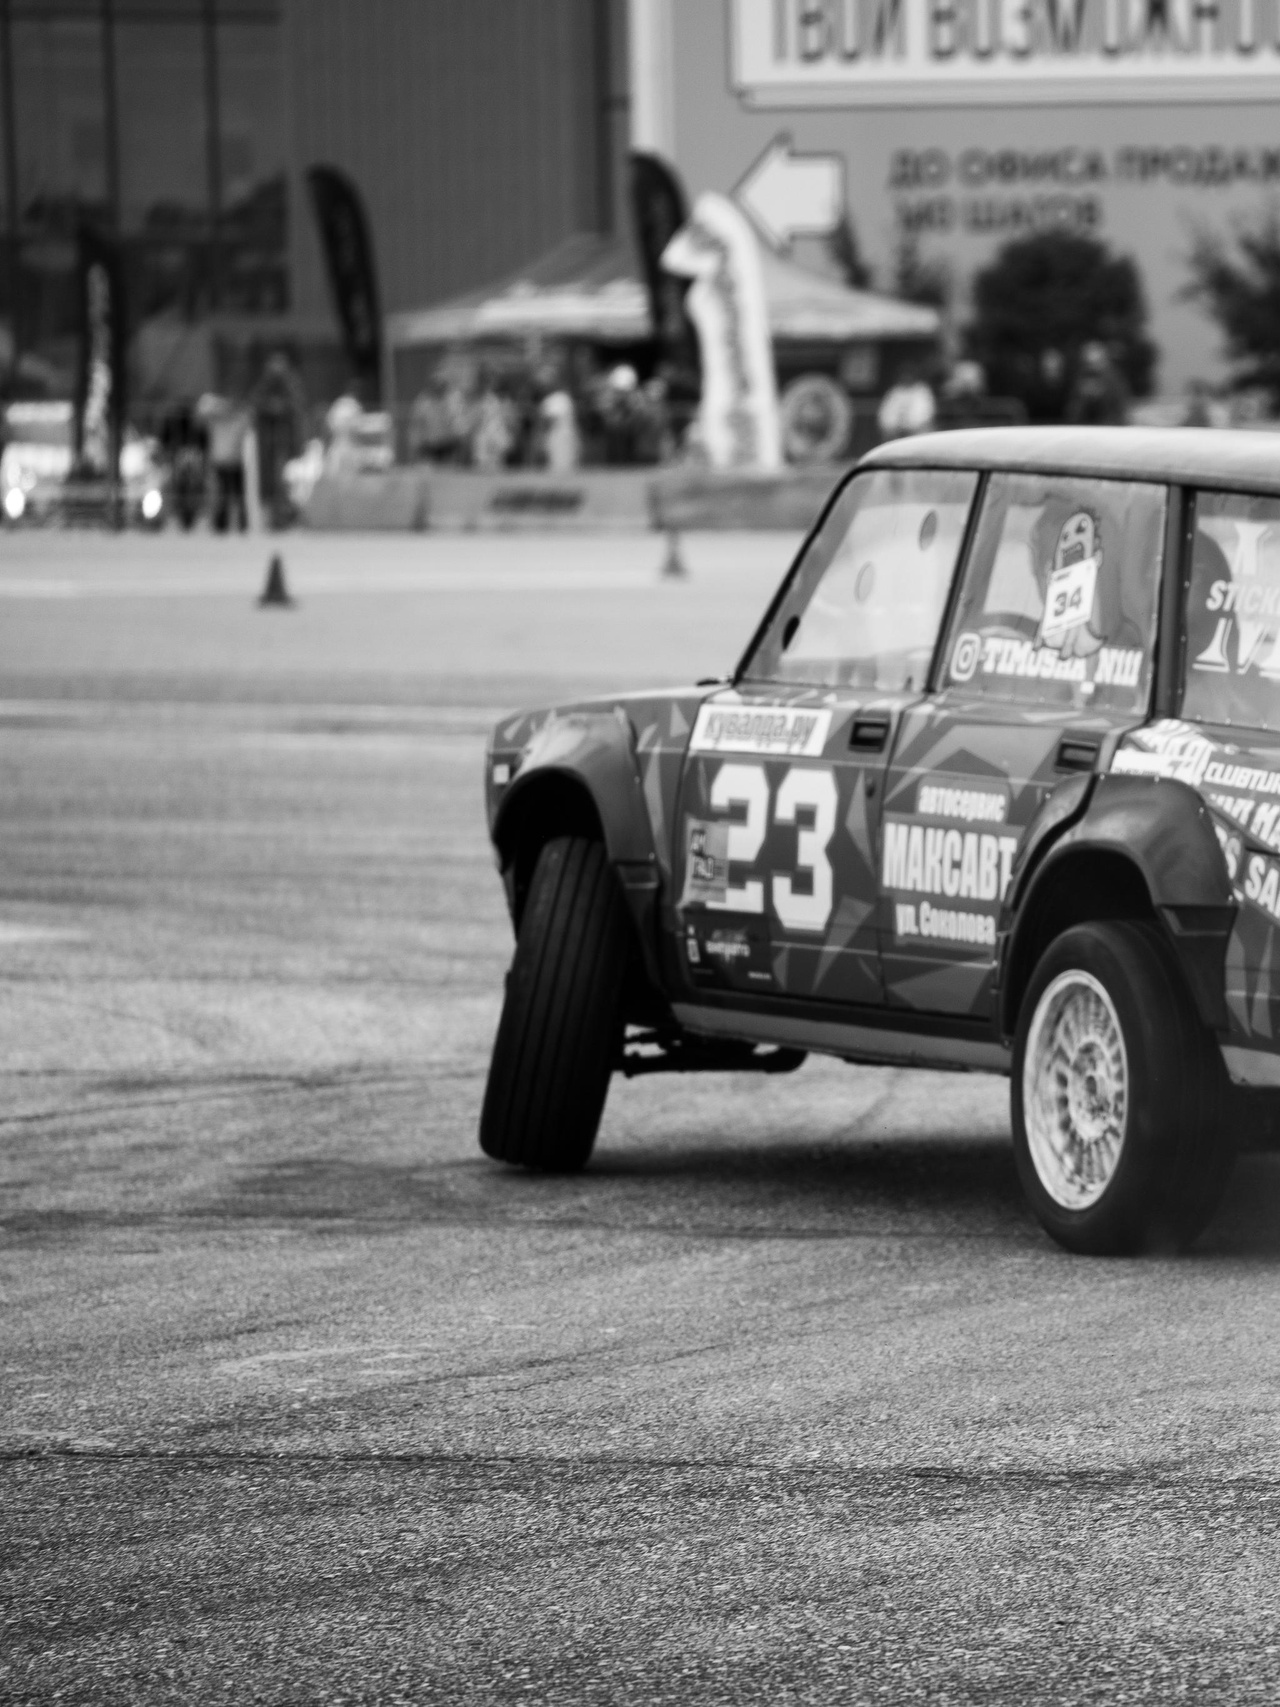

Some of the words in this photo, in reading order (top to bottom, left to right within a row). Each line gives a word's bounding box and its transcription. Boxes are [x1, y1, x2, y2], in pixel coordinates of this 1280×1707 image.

[1054, 586, 1082, 617] 34
[917, 785, 1006, 823] автосервис
[705, 763, 838, 932] 23
[895, 902, 918, 936] ул.
[918, 900, 997, 945] Соколова
